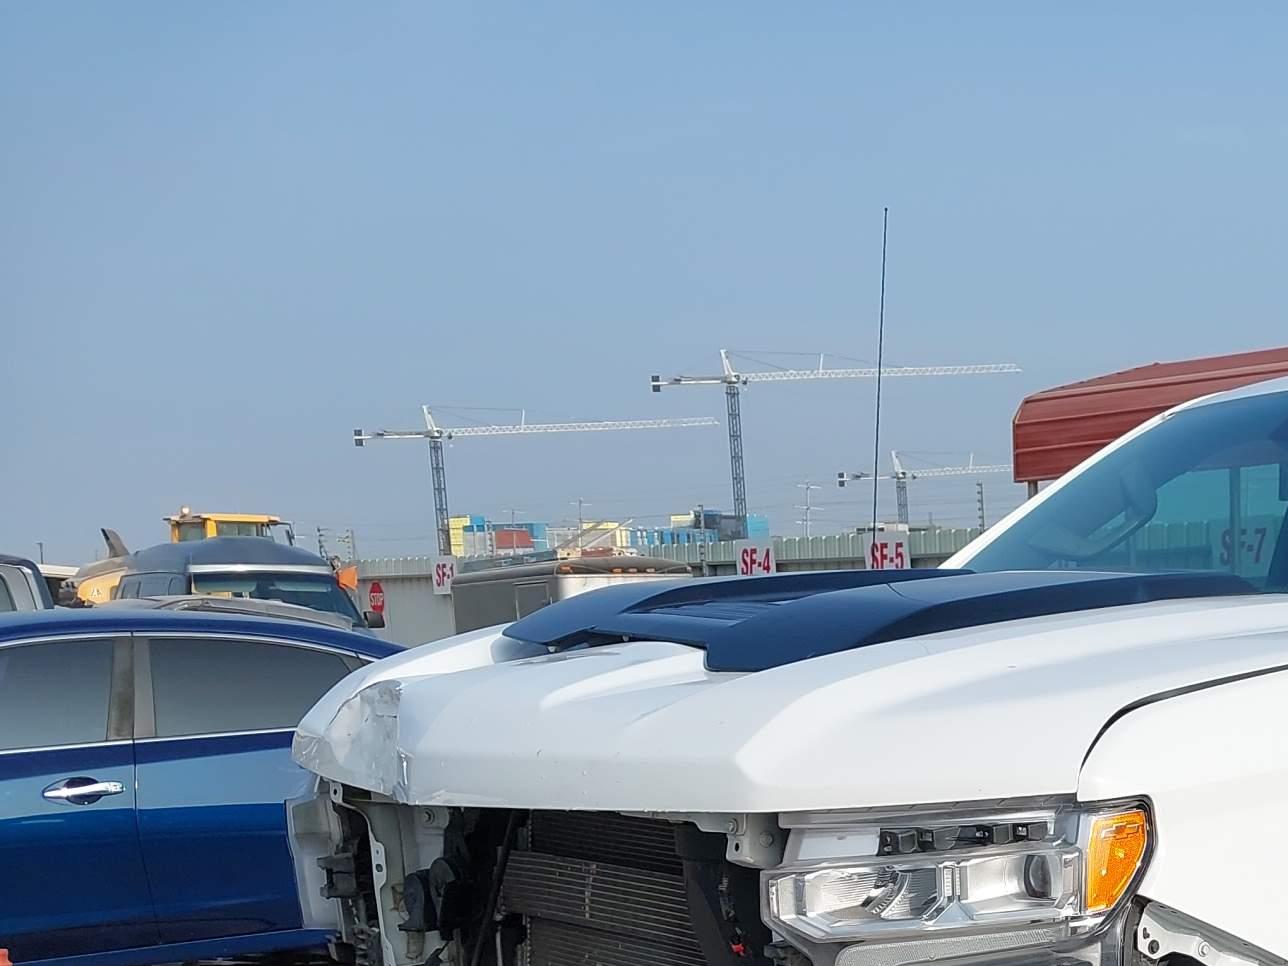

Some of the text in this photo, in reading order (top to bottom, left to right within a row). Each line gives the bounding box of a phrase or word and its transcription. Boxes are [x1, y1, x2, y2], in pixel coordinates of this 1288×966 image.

[741, 548, 772, 576] SF-4
[871, 542, 904, 570] SF-5
[436, 562, 454, 587] SF-1
[370, 592, 384, 606] STOP
